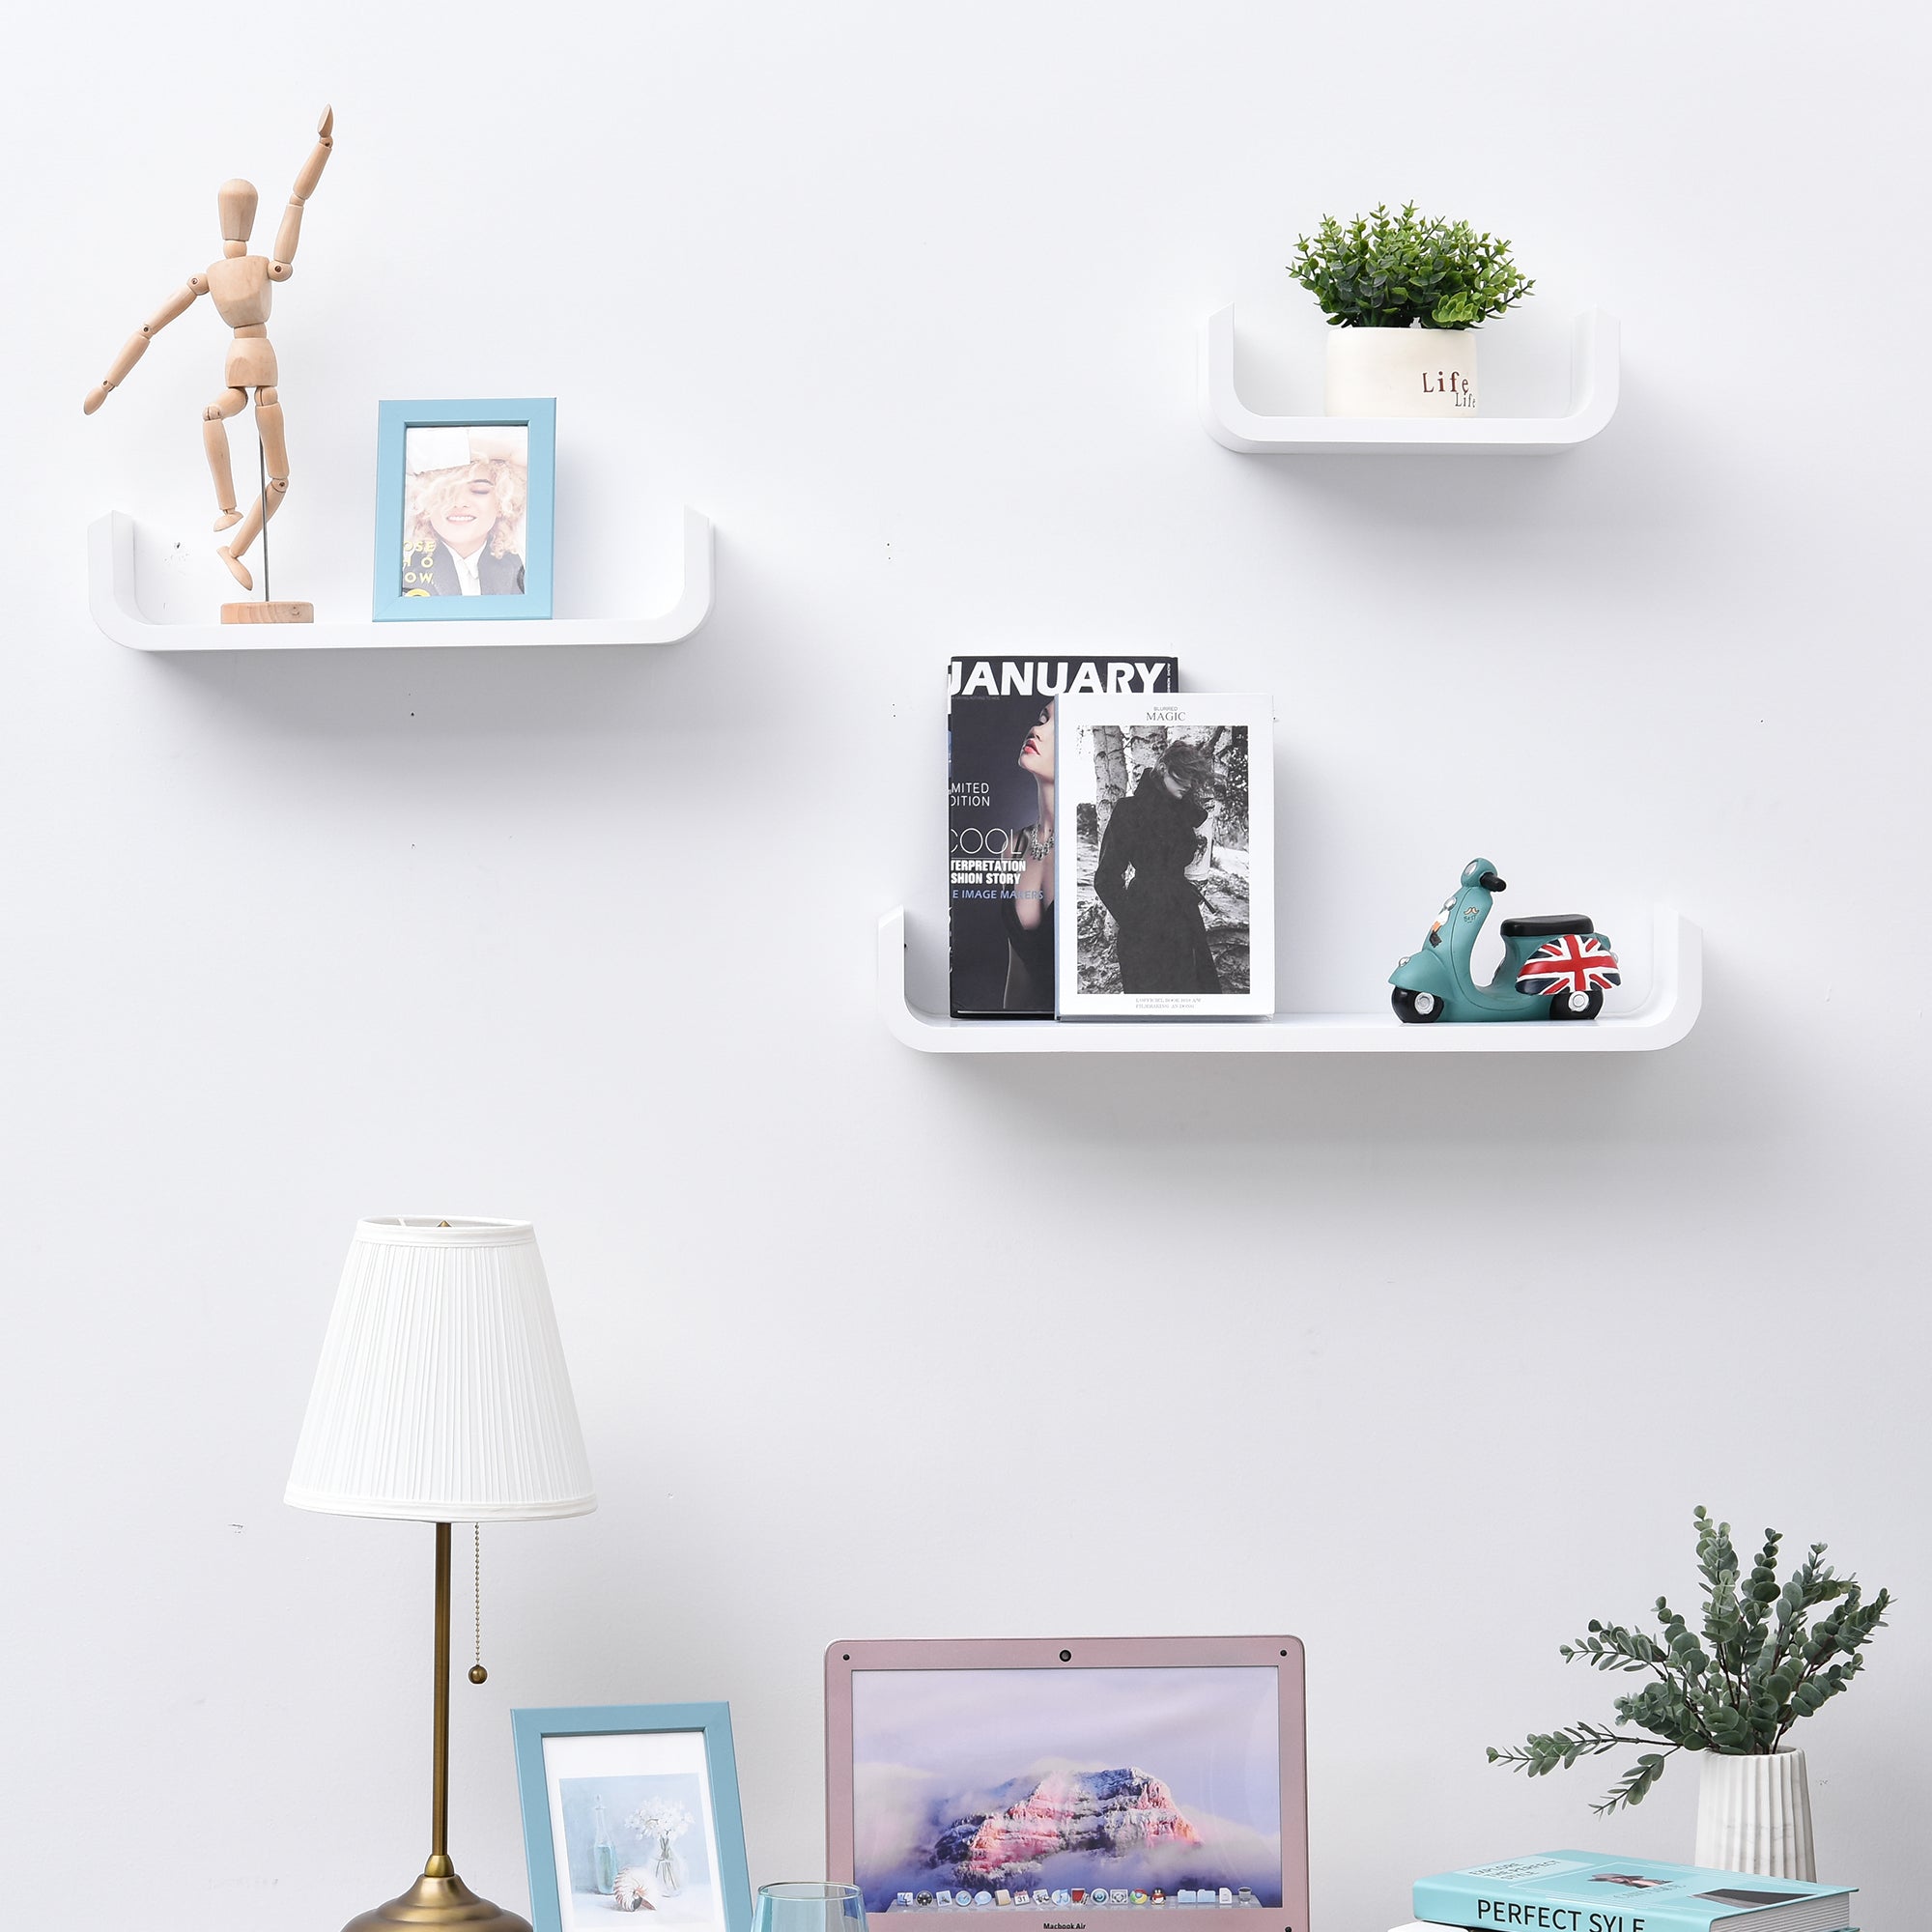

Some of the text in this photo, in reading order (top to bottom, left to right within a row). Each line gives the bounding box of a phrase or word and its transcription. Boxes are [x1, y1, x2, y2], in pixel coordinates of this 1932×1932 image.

[1422, 371, 1469, 396] Life
[949, 661, 1166, 696] JANUARY
[1146, 712, 1186, 721] MAGIC
[985, 872, 1021, 884] STORY
[961, 890, 997, 899] IMAGE
[1000, 890, 1044, 900] MAKERS
[1477, 1899, 1581, 1931] PERFECT
